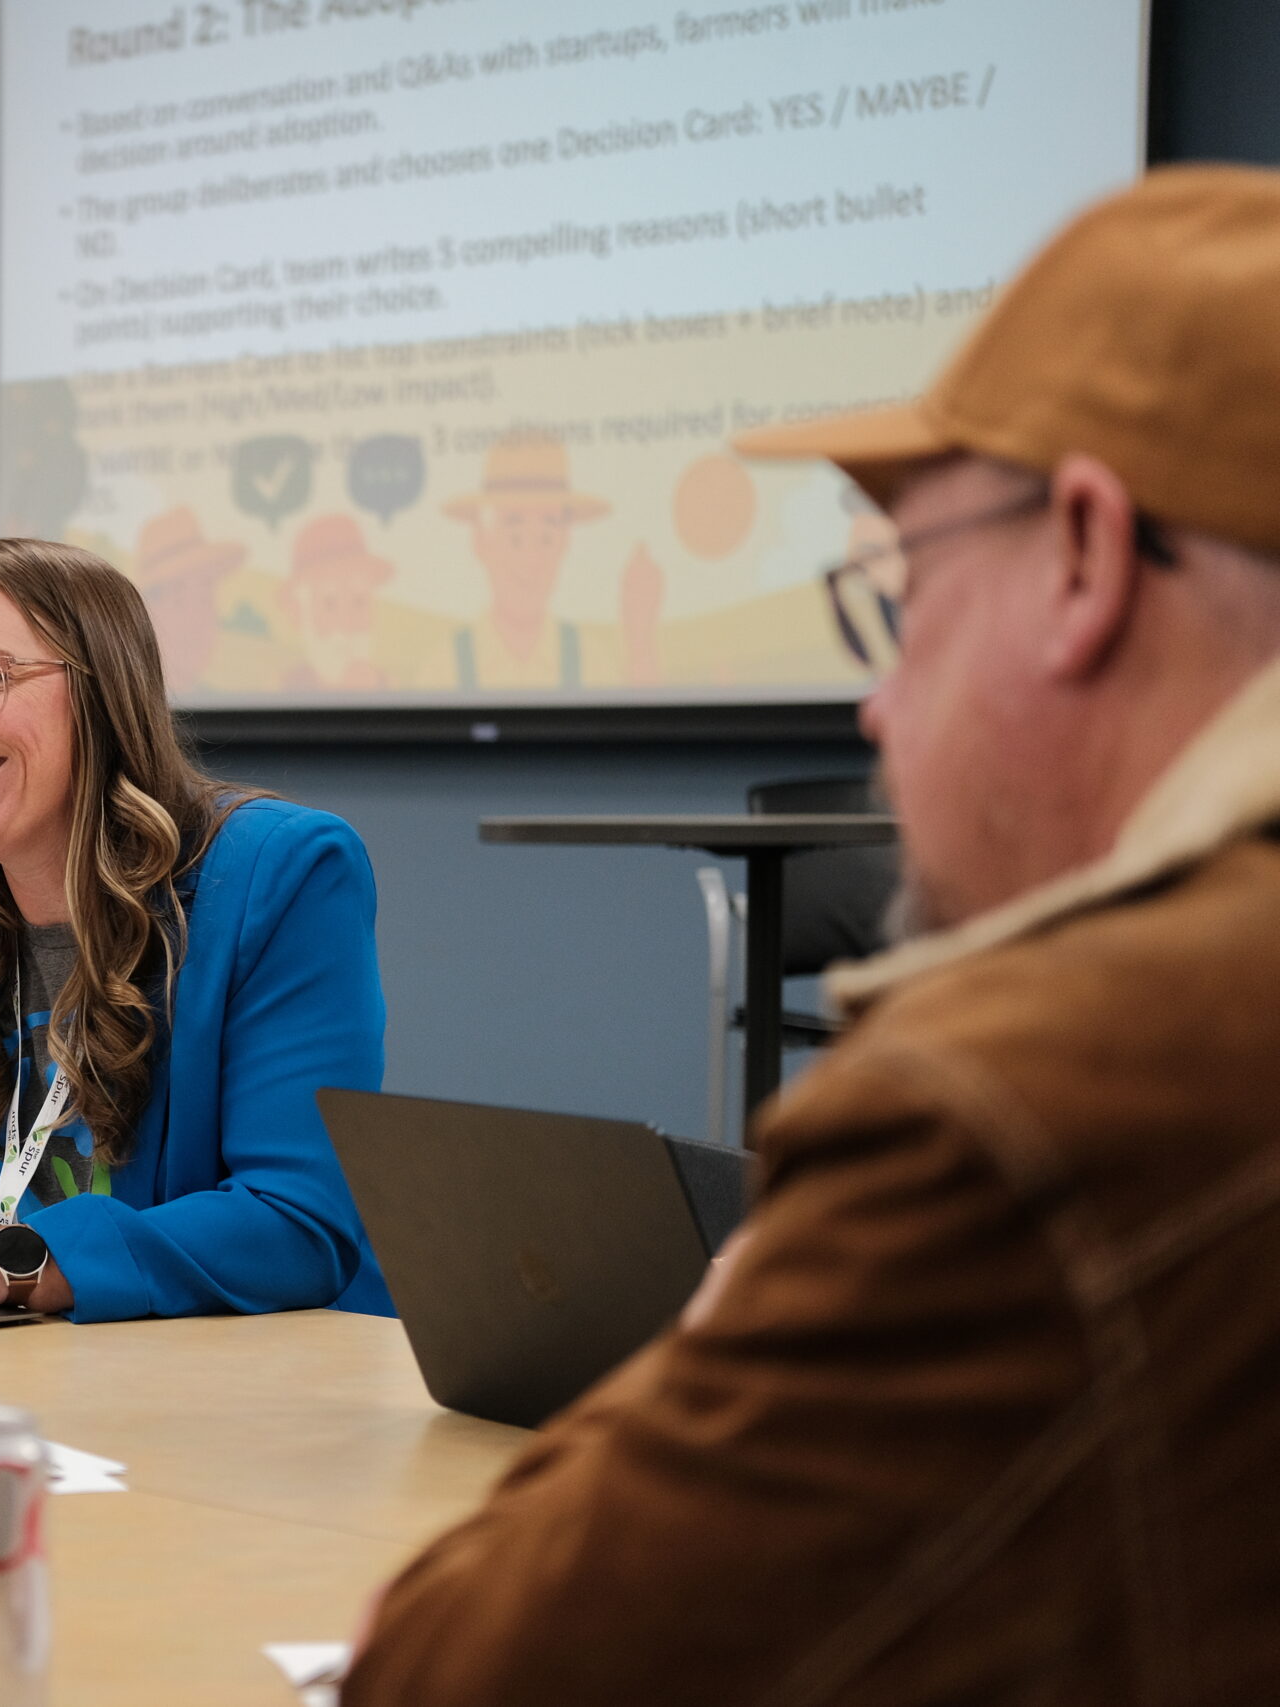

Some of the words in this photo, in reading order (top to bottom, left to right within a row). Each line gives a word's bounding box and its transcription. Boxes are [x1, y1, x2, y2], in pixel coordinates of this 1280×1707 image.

[69, 10, 185, 67] Round
[193, 4, 230, 46] 2:
[77, 103, 145, 139] Based
[152, 102, 179, 125] on
[185, 76, 337, 121] conversation
[344, 64, 392, 96] and
[397, 49, 474, 90] Q&As
[479, 37, 539, 75] with
[545, 22, 668, 68] startups,
[675, 3, 790, 46] farmers
[75, 139, 168, 175] decision
[175, 127, 259, 162] around
[267, 107, 385, 150] adoption.
[77, 193, 117, 223] The
[122, 187, 190, 225] group
[196, 165, 329, 208] deliberates
[335, 154, 384, 188] and
[388, 144, 493, 183] chooses
[499, 137, 552, 167] one
[558, 115, 676, 159] Decision
[684, 102, 762, 144] Card:
[770, 91, 825, 131] YES
[831, 86, 850, 129] /
[856, 72, 969, 121] MAYBE
[977, 64, 997, 109] /
[76, 280, 107, 308] On
[113, 270, 209, 305] Decision
[282, 256, 349, 286] team
[353, 243, 433, 277] writes
[458, 221, 611, 269] compelling
[618, 208, 729, 245] reasons
[735, 195, 827, 242] (short
[835, 182, 926, 222] bullet
[160, 295, 286, 339] supporting
[291, 289, 352, 322] their
[357, 280, 446, 317] choice.
[422, 324, 570, 362] constraints
[644, 308, 730, 341] boxes
[762, 293, 838, 335] brief
[842, 284, 926, 328] note)
[934, 277, 995, 314] and
[454, 415, 592, 456] conditions
[600, 404, 724, 448] required
[731, 398, 777, 430] for
[51, 1074, 67, 1104] spur
[18, 1146, 36, 1176] spur
[33, 1148, 41, 1160] the
